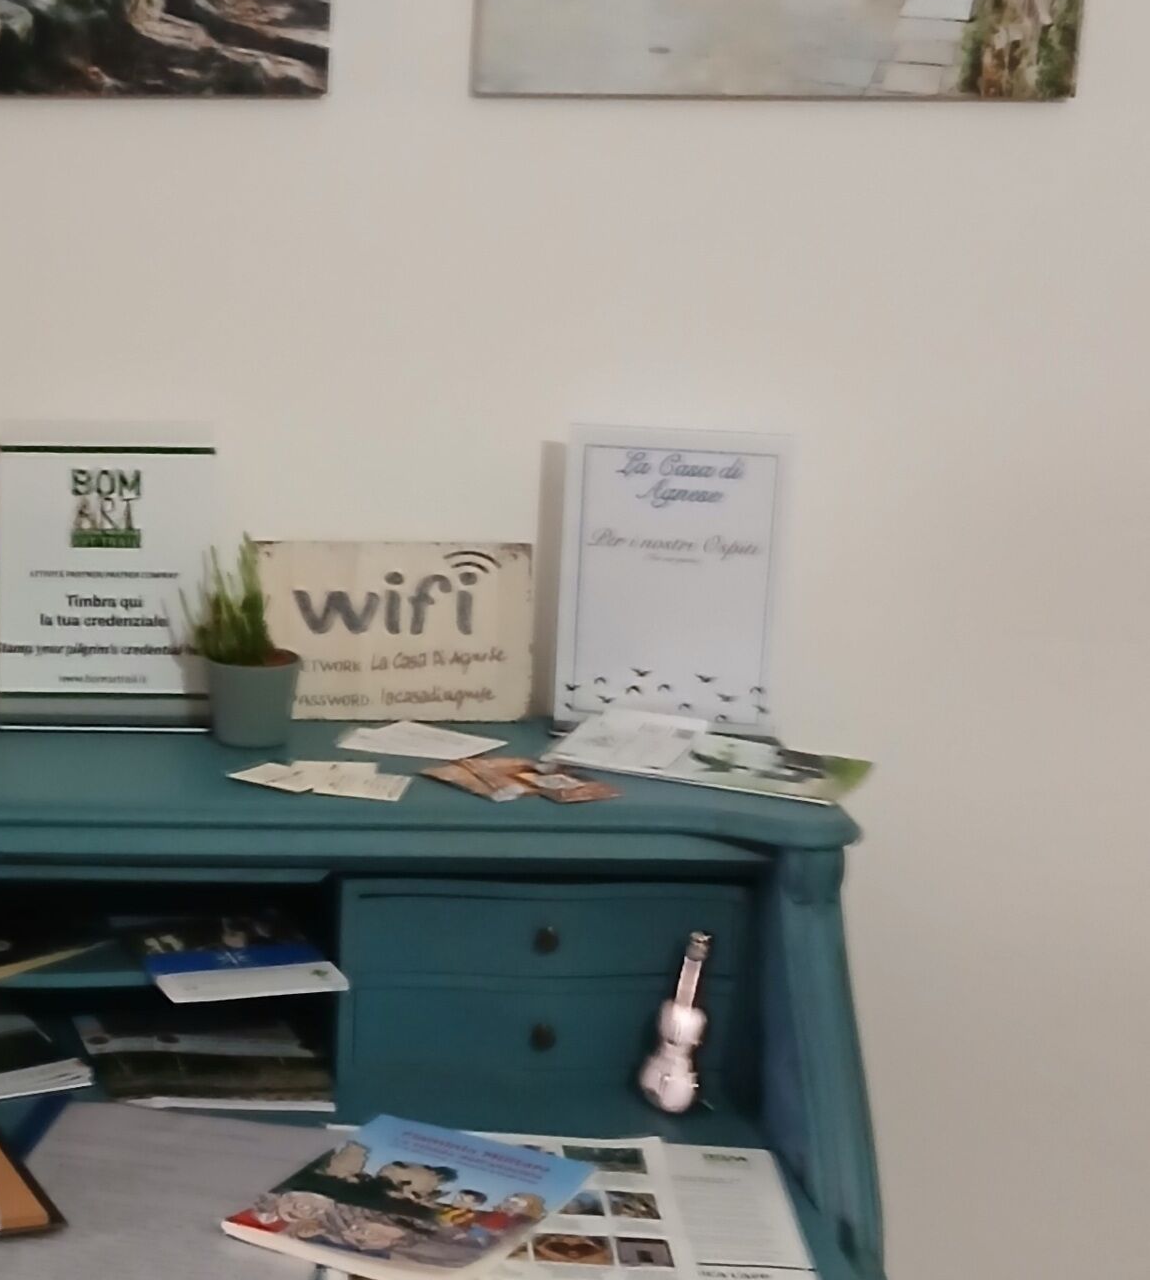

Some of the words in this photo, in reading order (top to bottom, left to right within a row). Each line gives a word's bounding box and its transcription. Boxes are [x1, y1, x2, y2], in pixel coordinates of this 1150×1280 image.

[616, 451, 650, 476] La
[659, 453, 715, 477] Casa
[719, 457, 744, 479] di
[71, 469, 141, 496] BOM
[73, 496, 139, 530] ART
[587, 528, 625, 547] Per
[66, 594, 116, 608] Timbra
[120, 594, 143, 611] qui
[292, 571, 478, 635] wifi
[40, 613, 53, 627] la
[57, 615, 80, 627] tua
[84, 613, 169, 628] credenziale
[296, 693, 370, 707] ASSWORD
